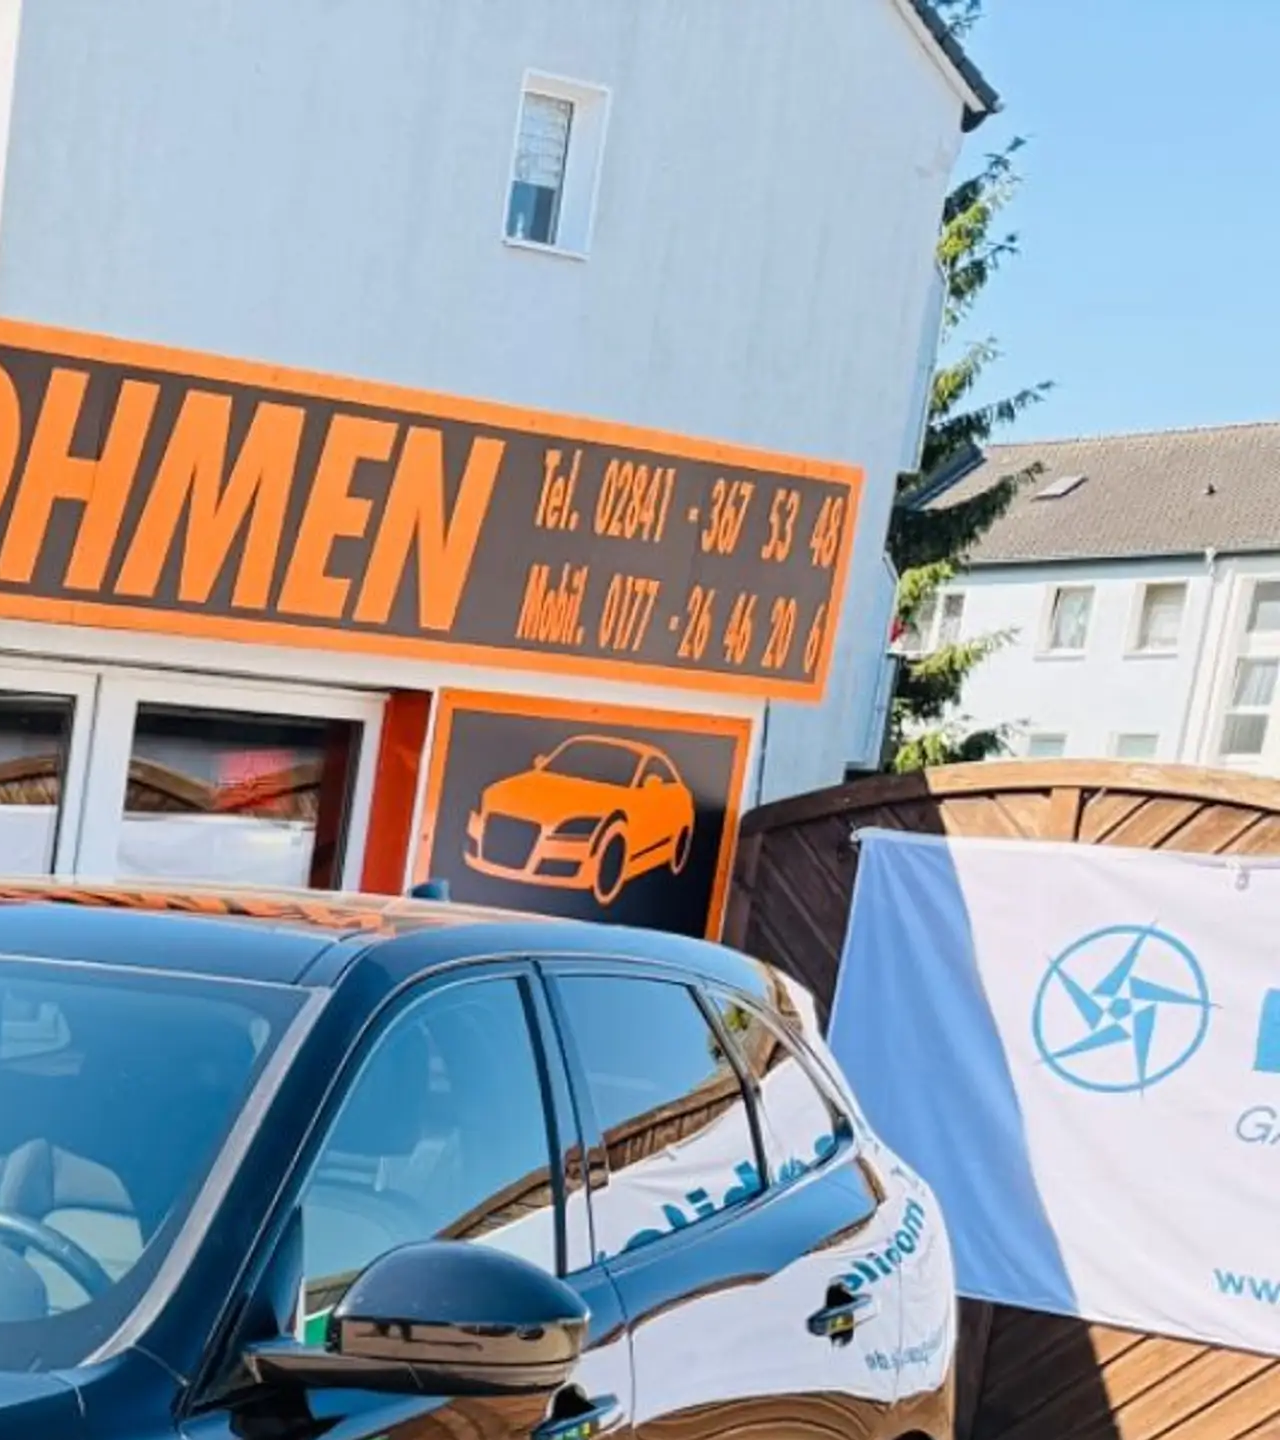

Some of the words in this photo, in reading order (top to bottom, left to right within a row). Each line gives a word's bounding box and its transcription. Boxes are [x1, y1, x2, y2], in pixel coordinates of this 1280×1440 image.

[535, 449, 583, 531] Tel.
[594, 458, 676, 544] 02841
[702, 477, 755, 556] 367
[762, 488, 800, 563] 53
[810, 496, 844, 568] 48
[516, 563, 587, 646] Mobil.
[598, 573, 660, 653] 0177
[678, 585, 716, 661] 26
[723, 593, 756, 666] 46
[761, 597, 797, 669] 20
